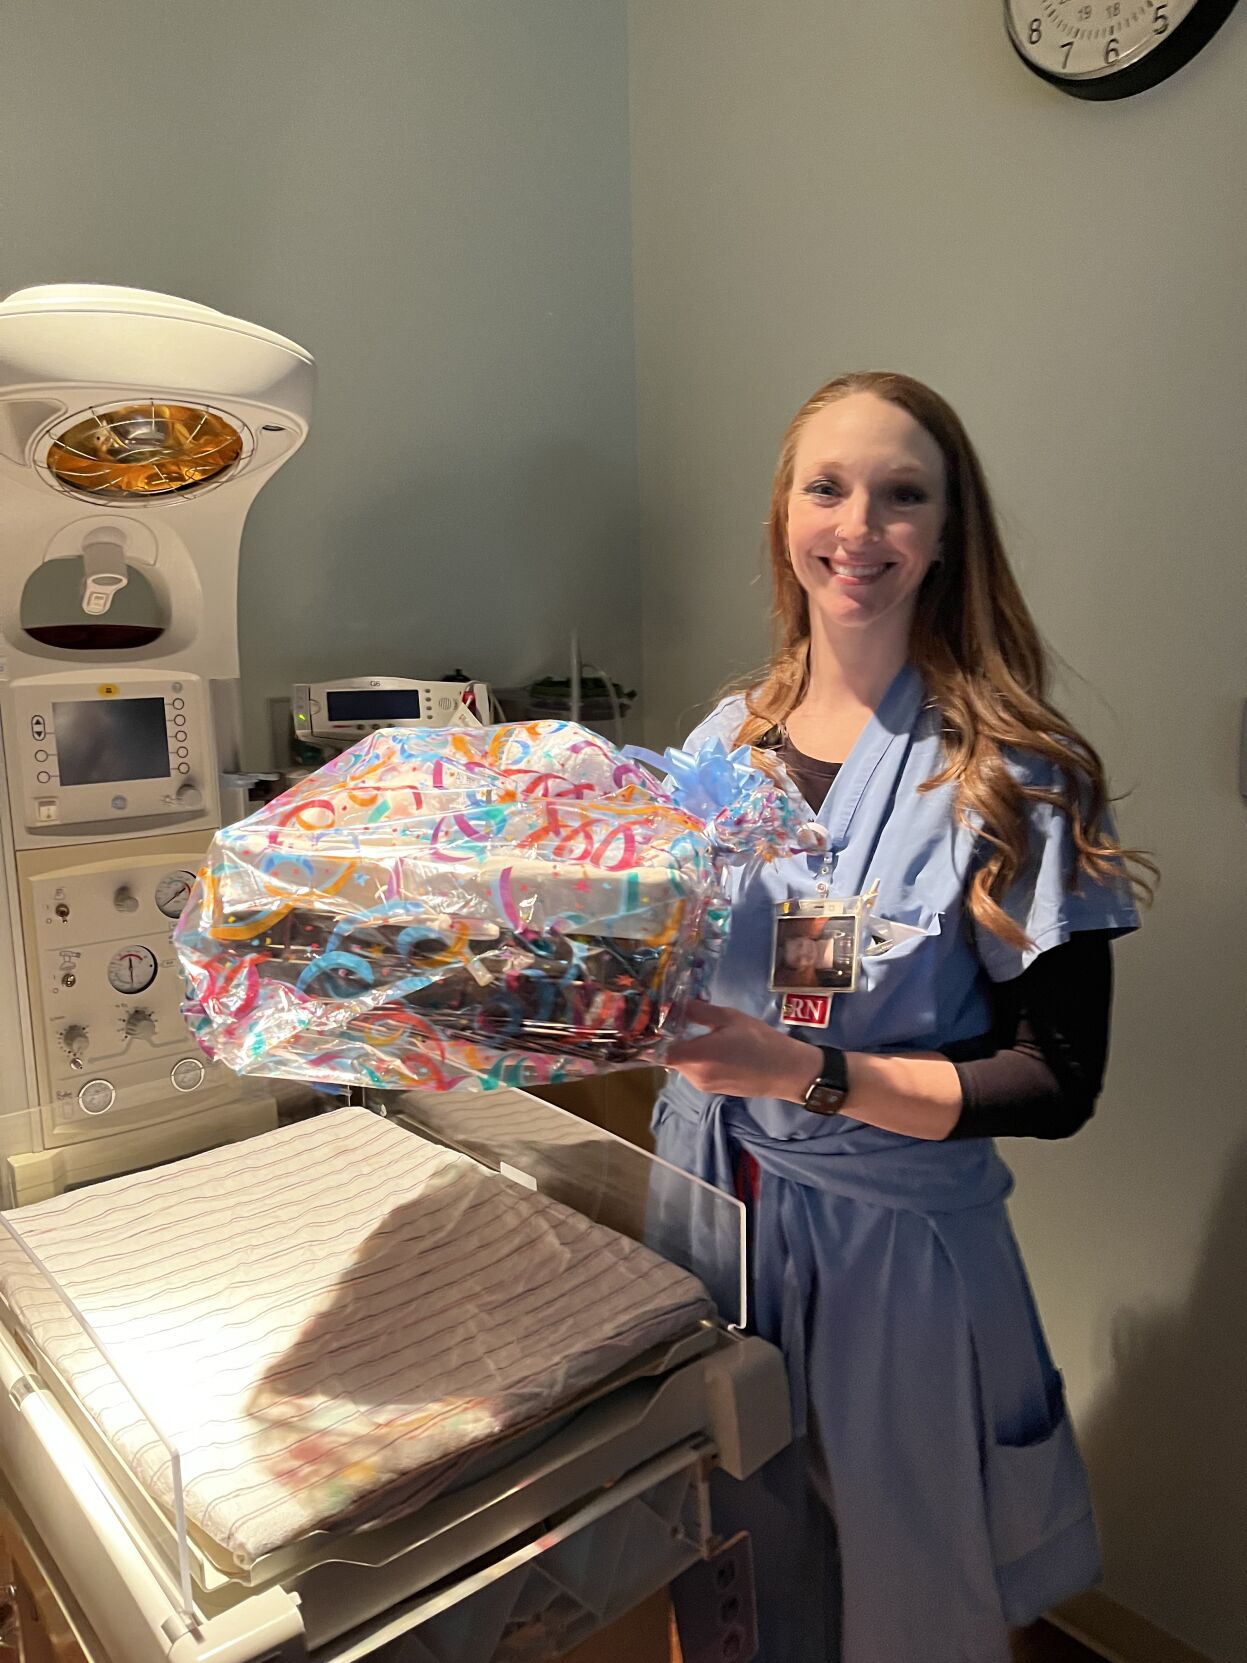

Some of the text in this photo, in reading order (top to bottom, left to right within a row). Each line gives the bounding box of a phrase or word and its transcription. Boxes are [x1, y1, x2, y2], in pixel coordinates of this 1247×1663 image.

[1106, 2, 1120, 18] 18
[1152, 4, 1169, 35] 5
[1028, 18, 1041, 44] 8
[1059, 41, 1075, 69] 7
[1104, 38, 1119, 65] 6
[790, 998, 823, 1021] RN
